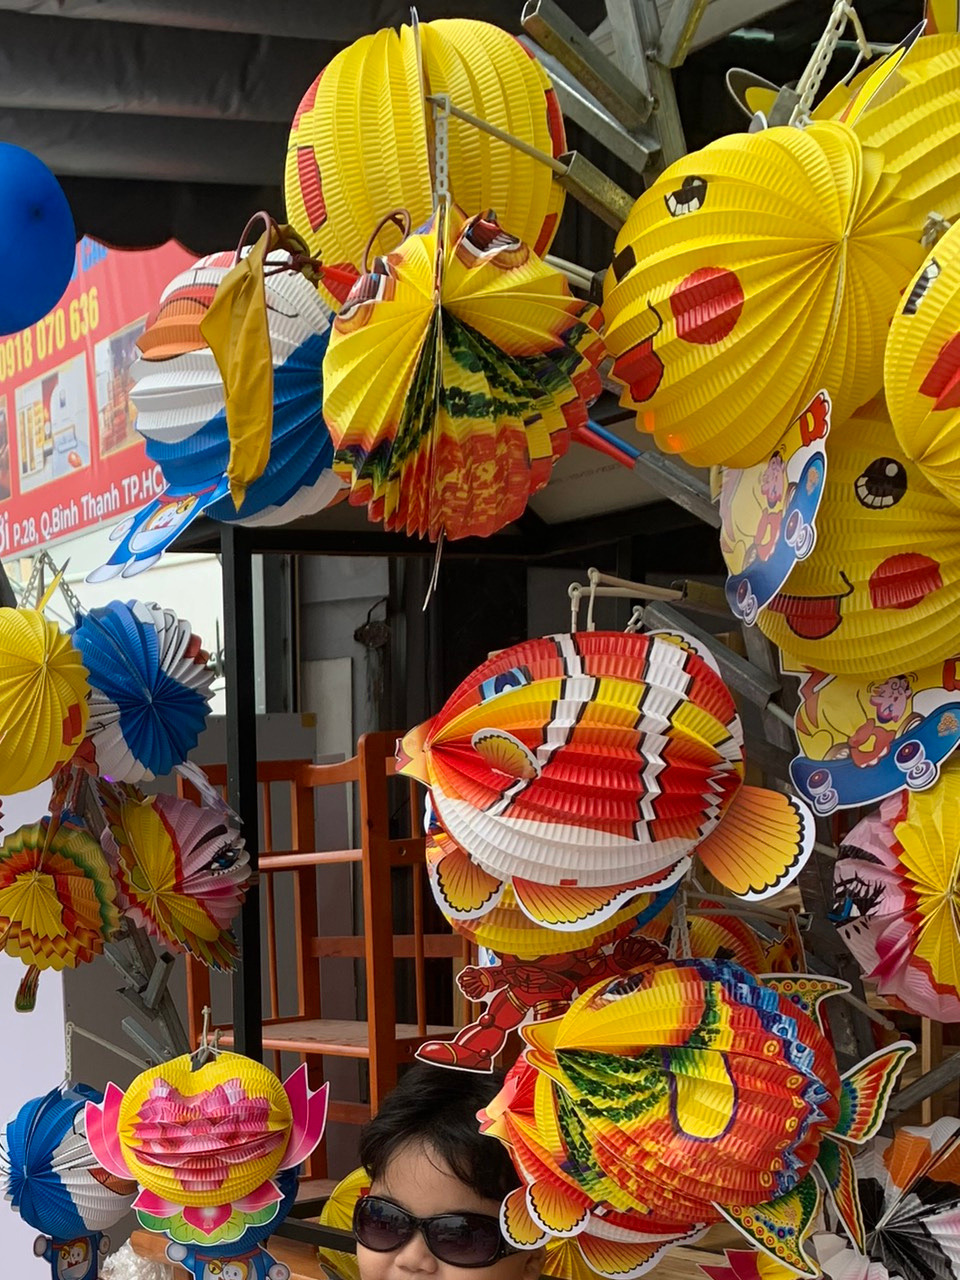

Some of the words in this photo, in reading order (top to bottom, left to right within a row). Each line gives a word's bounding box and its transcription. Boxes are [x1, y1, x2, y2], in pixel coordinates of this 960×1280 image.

[35, 307, 66, 361] 070
[69, 286, 99, 342] 636
[41, 499, 79, 540] Q.Bình
[81, 483, 120, 522] Thạnh
[122, 464, 166, 505] TP.HC
